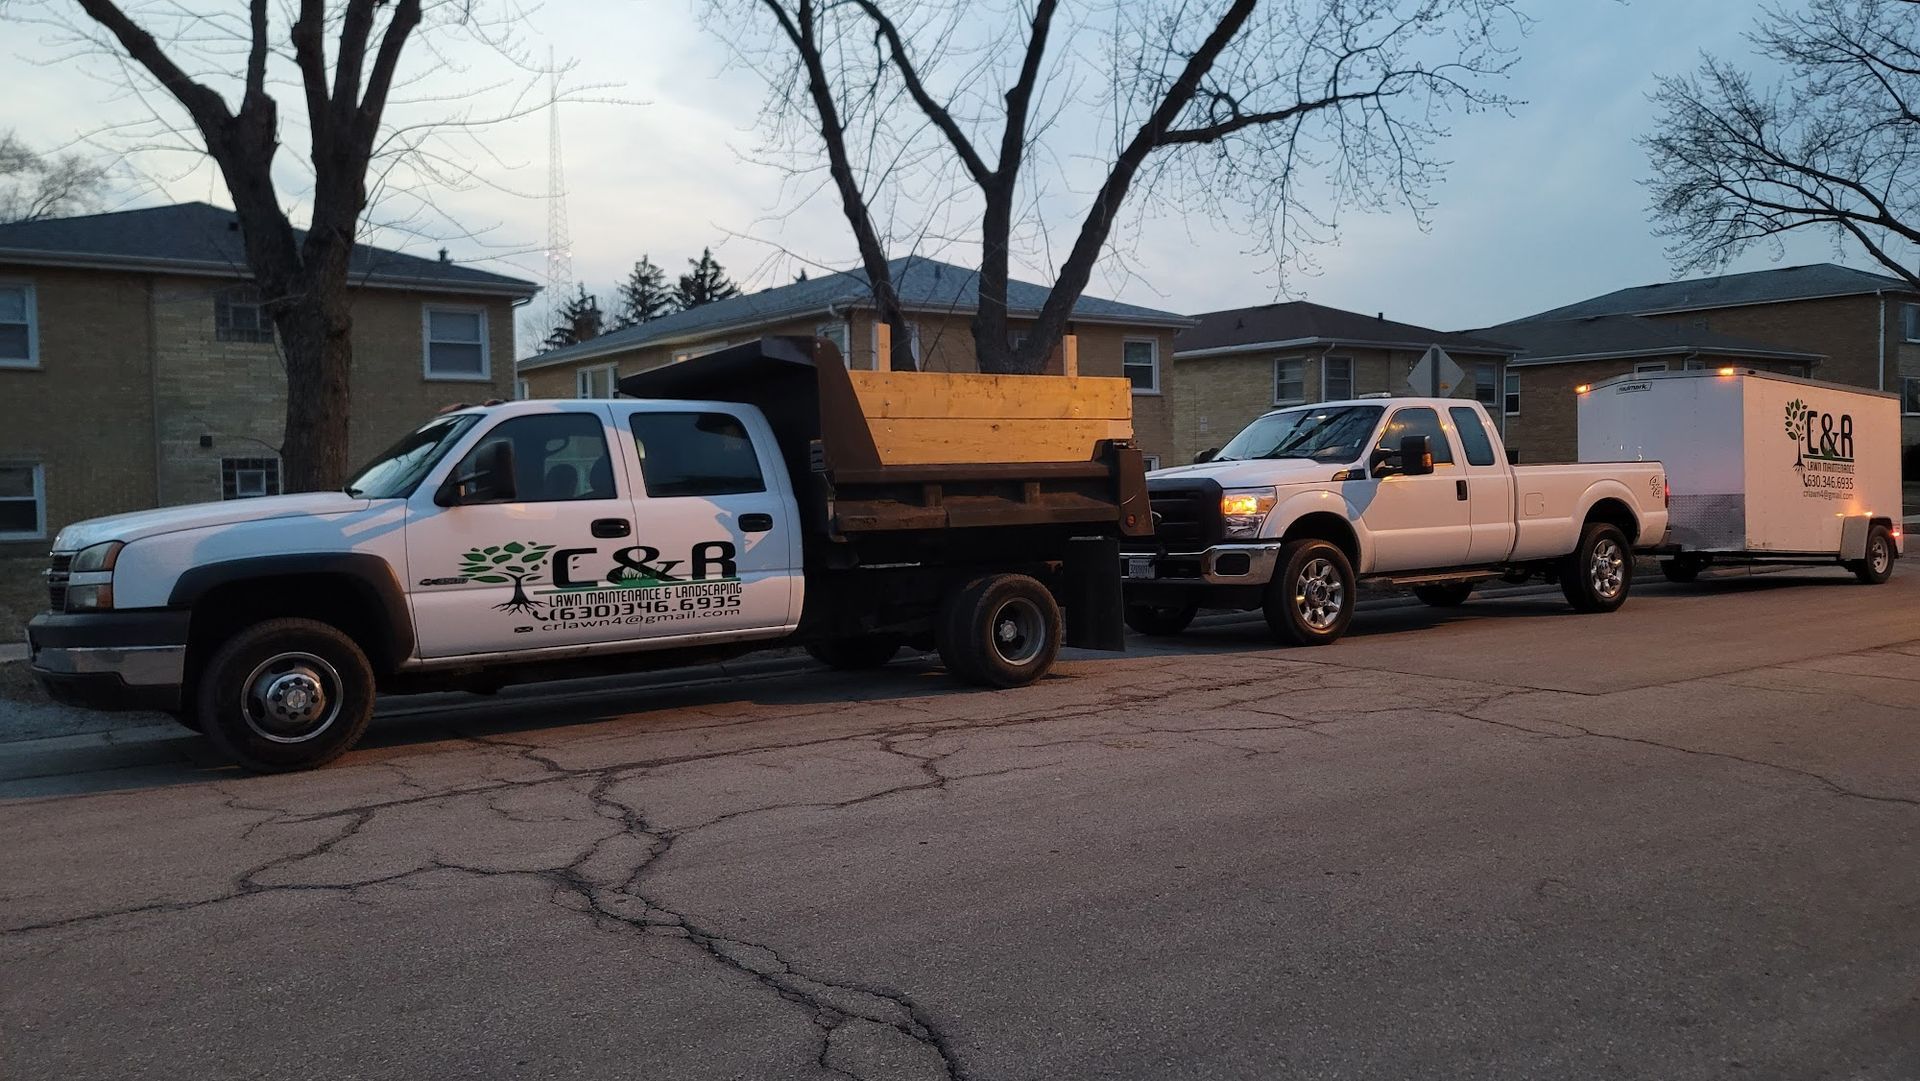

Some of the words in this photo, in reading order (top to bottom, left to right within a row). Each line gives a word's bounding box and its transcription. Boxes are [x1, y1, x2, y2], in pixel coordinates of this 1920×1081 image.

[1807, 461, 1821, 472] LAWN
[1823, 462, 1855, 475] MAINTENANCE
[1807, 474, 1854, 489] 630.346.6935
[550, 592, 582, 608] LAWN
[586, 588, 661, 605] MAINTENANCE
[665, 586, 672, 599] &
[675, 582, 743, 599] LANDSCAPING
[542, 608, 740, 632] crlawn4@gmail.com
